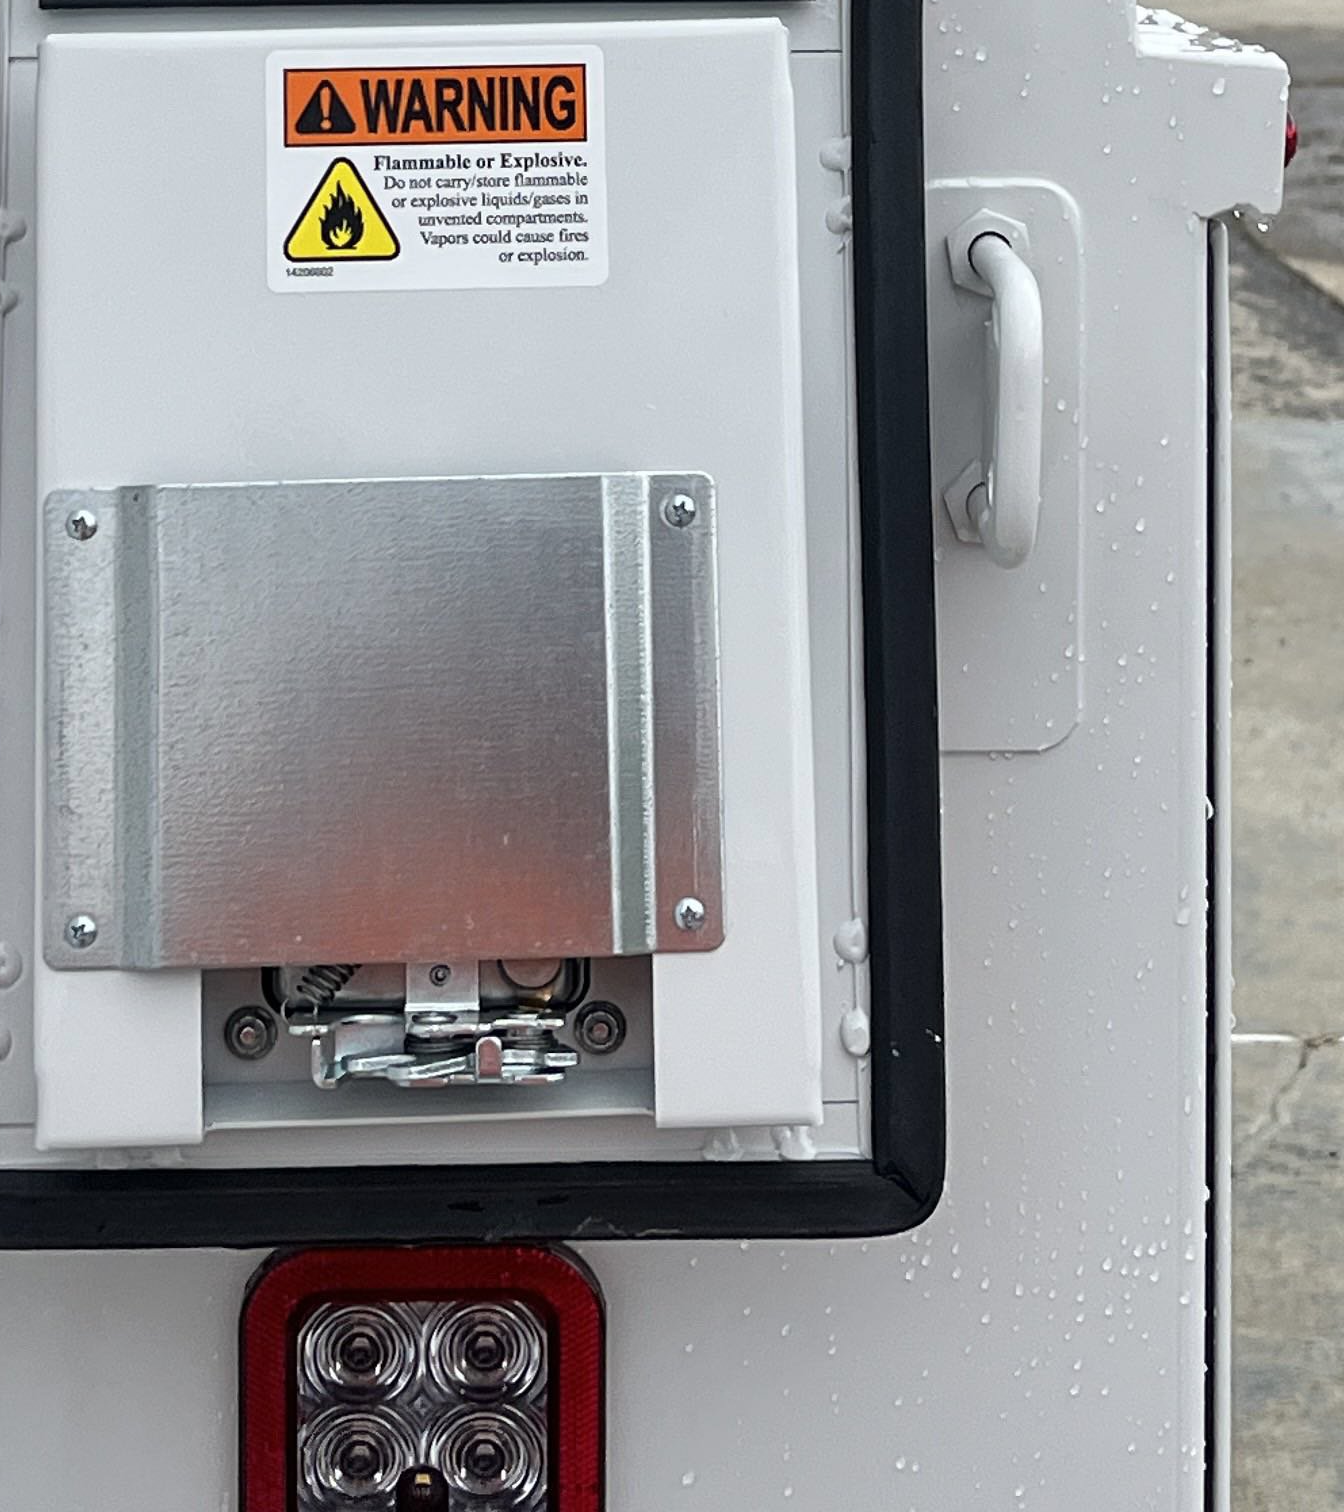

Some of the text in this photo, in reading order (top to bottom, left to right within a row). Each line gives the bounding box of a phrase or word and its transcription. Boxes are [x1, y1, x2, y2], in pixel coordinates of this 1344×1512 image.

[360, 75, 577, 134] WARNING
[373, 152, 587, 172] Flammable or Explosive.
[383, 171, 588, 191] Do not carry/store flammable
[391, 191, 588, 211] or explosive liquids/gases in
[418, 211, 588, 228] unvented compartments.
[420, 228, 589, 248] Vapors could cause fires
[498, 247, 589, 266] or explosion.
